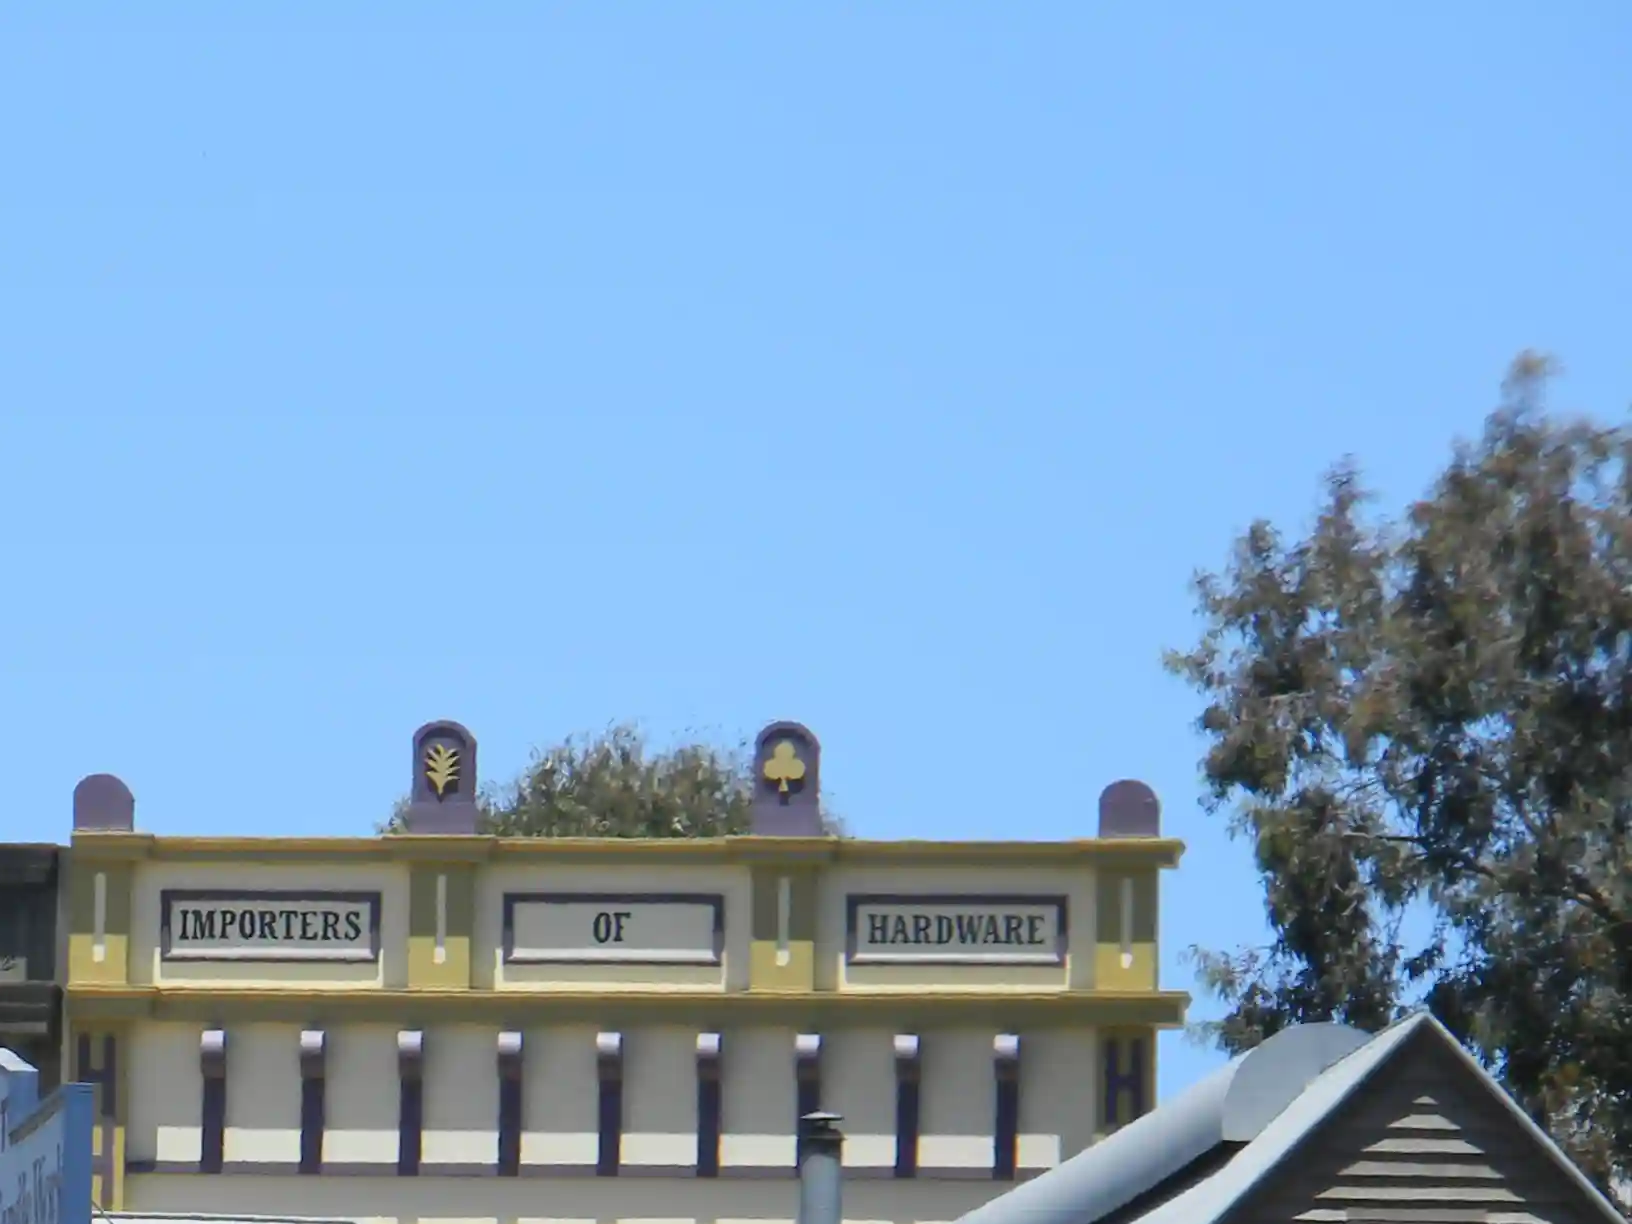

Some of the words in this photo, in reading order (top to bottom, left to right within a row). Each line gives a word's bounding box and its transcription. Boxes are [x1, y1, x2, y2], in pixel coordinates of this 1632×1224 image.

[179, 909, 362, 941] IMPORTERS
[593, 912, 632, 943] OF
[868, 913, 1046, 945] HARDWARE
